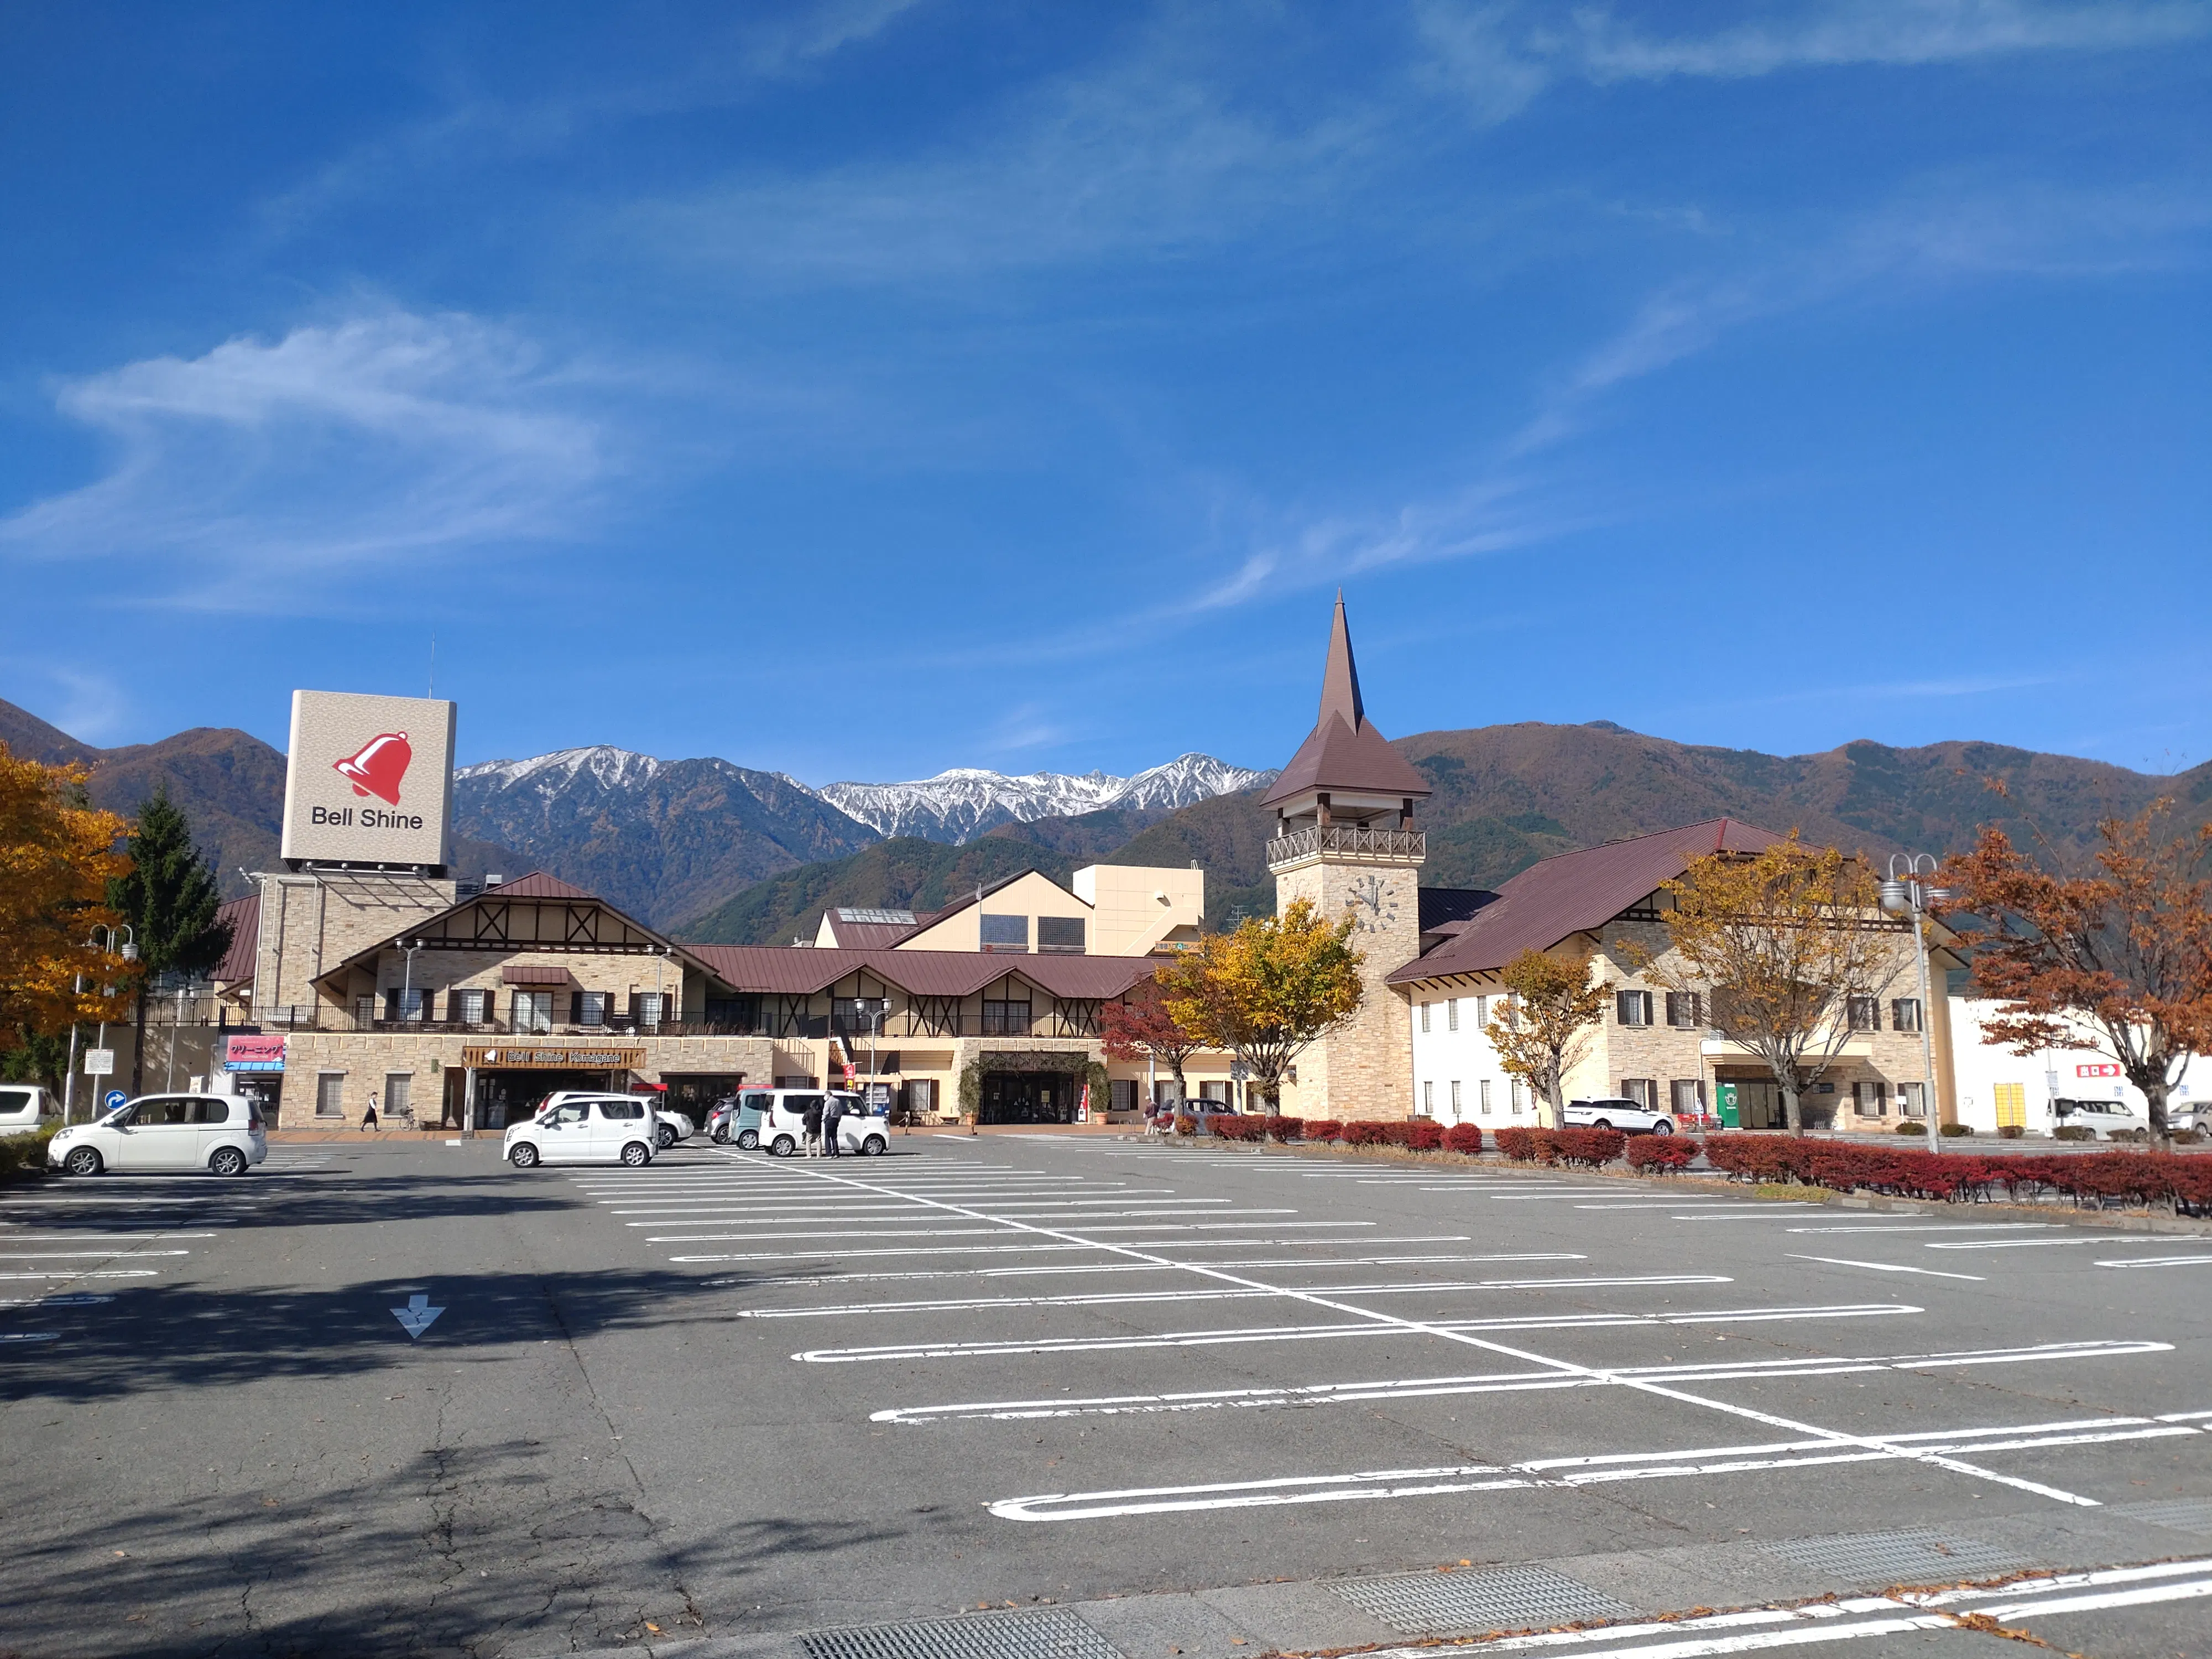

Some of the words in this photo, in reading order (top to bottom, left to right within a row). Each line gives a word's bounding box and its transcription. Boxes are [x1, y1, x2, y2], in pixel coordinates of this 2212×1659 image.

[311, 806, 353, 826] Bell
[360, 809, 423, 830] Shine
[231, 1044, 281, 1054] クリーニング
[508, 1052, 529, 1062] Bell
[534, 1052, 564, 1062] Shine
[570, 1053, 620, 1064] Komagane
[2080, 1065, 2100, 1077] 出口
